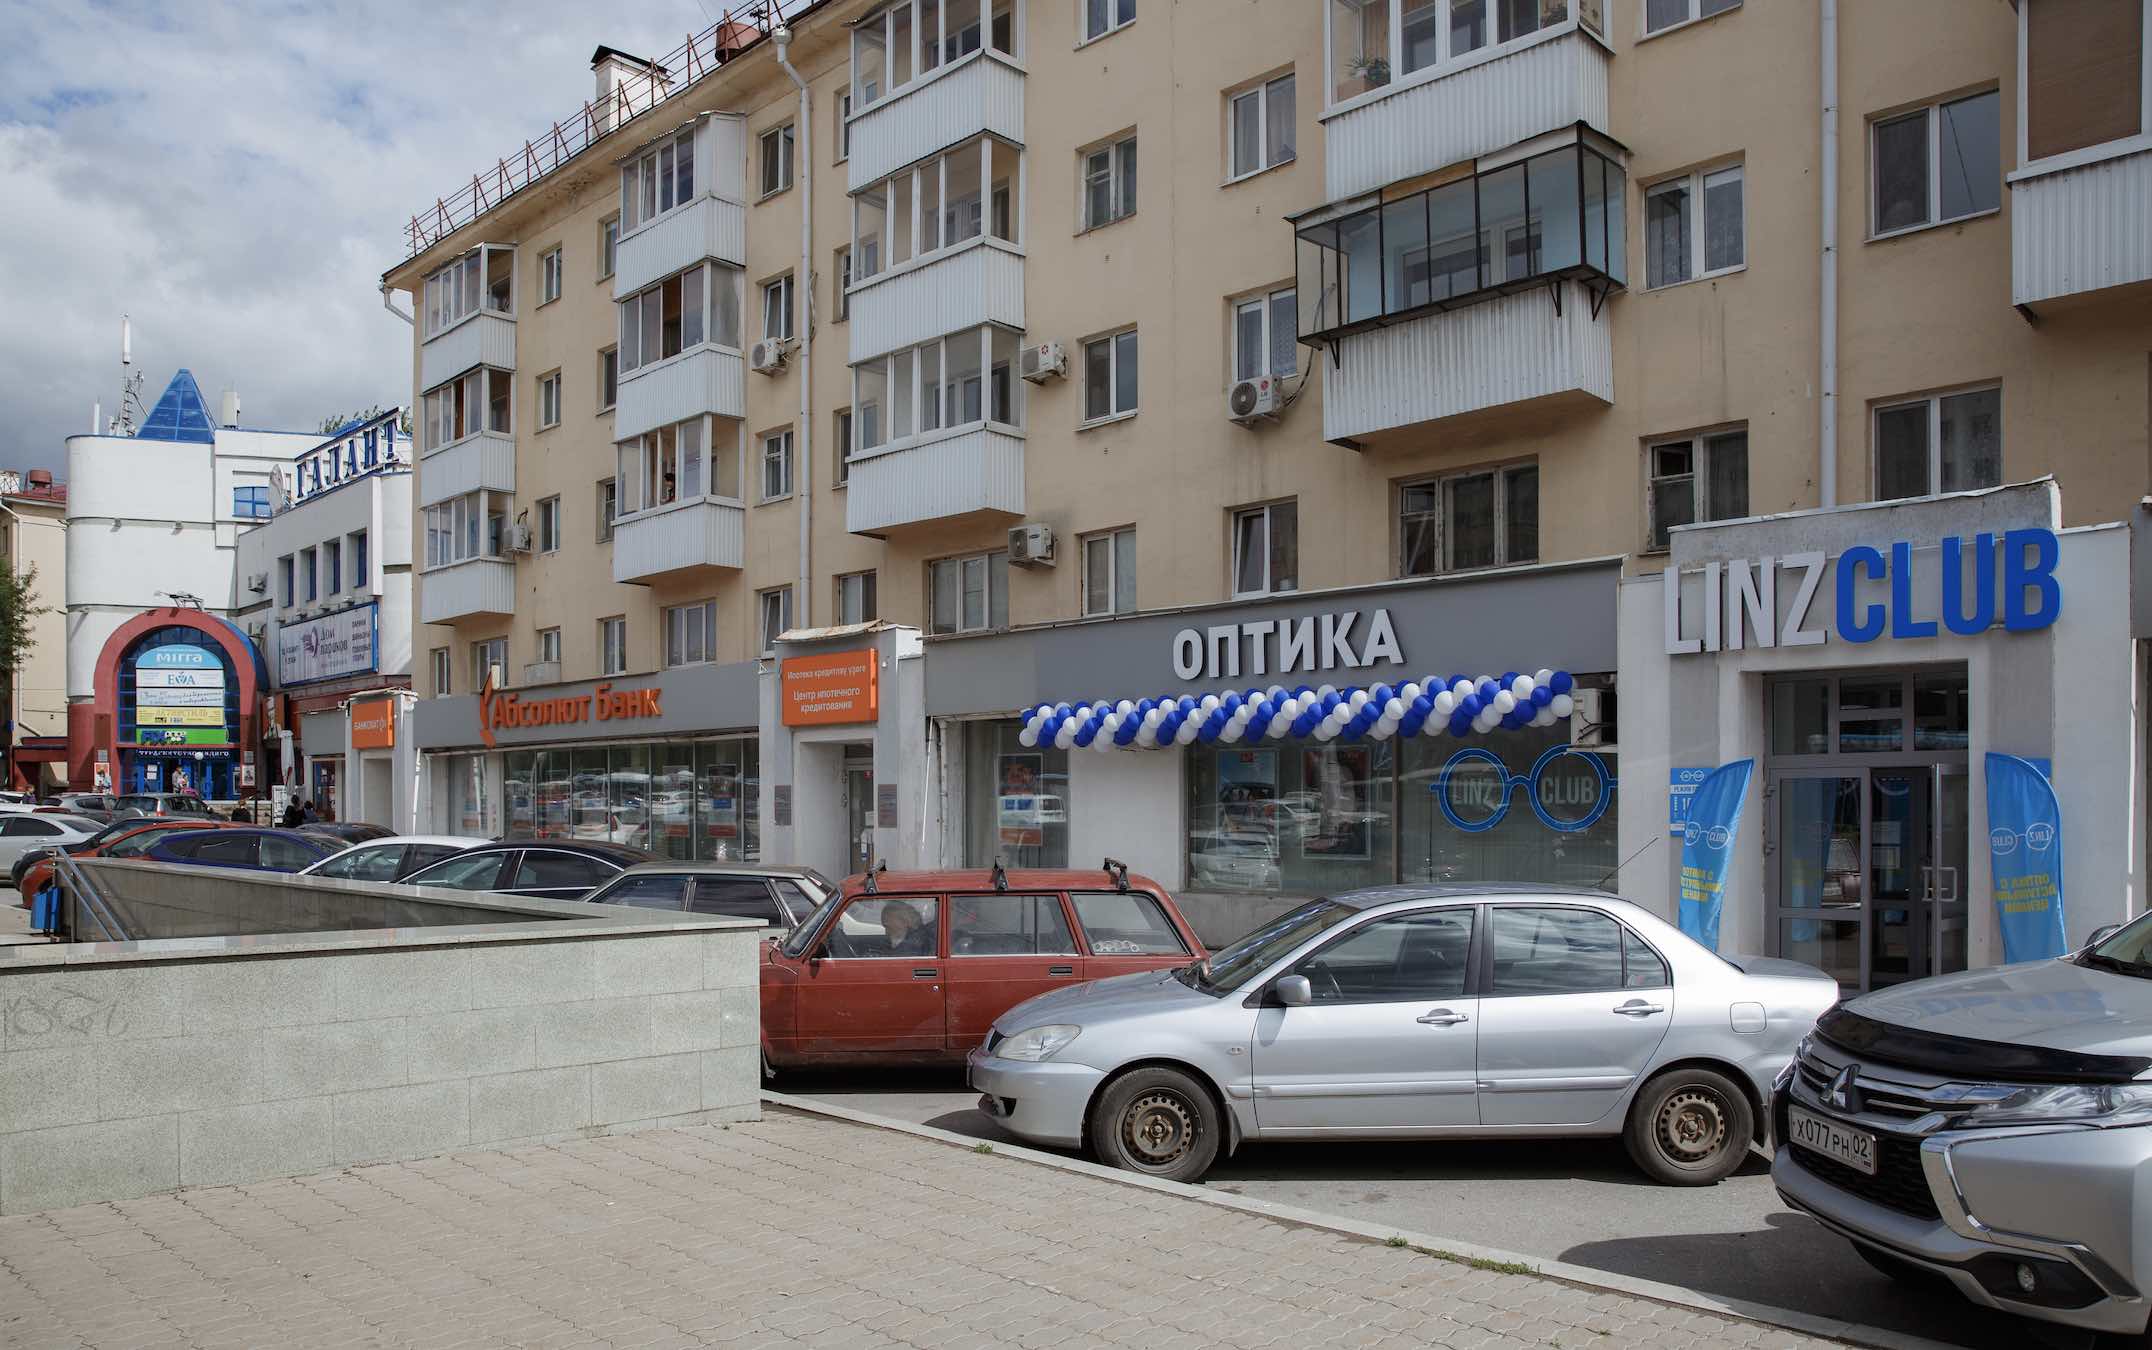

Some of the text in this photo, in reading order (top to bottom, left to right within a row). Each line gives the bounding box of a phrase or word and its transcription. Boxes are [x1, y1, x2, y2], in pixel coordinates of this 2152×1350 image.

[296, 417, 399, 499] ГАЛАНТ
[1664, 528, 2063, 655] LINZ CLUB
[1173, 609, 1405, 680] ОПТИКА
[493, 683, 663, 730] Абсолют Банк
[793, 688, 861, 703] Центр ипотечного
[801, 701, 854, 714] кредитования
[1453, 776, 1595, 806] LINZ CLUB
[1853, 1135, 1867, 1157] 02
